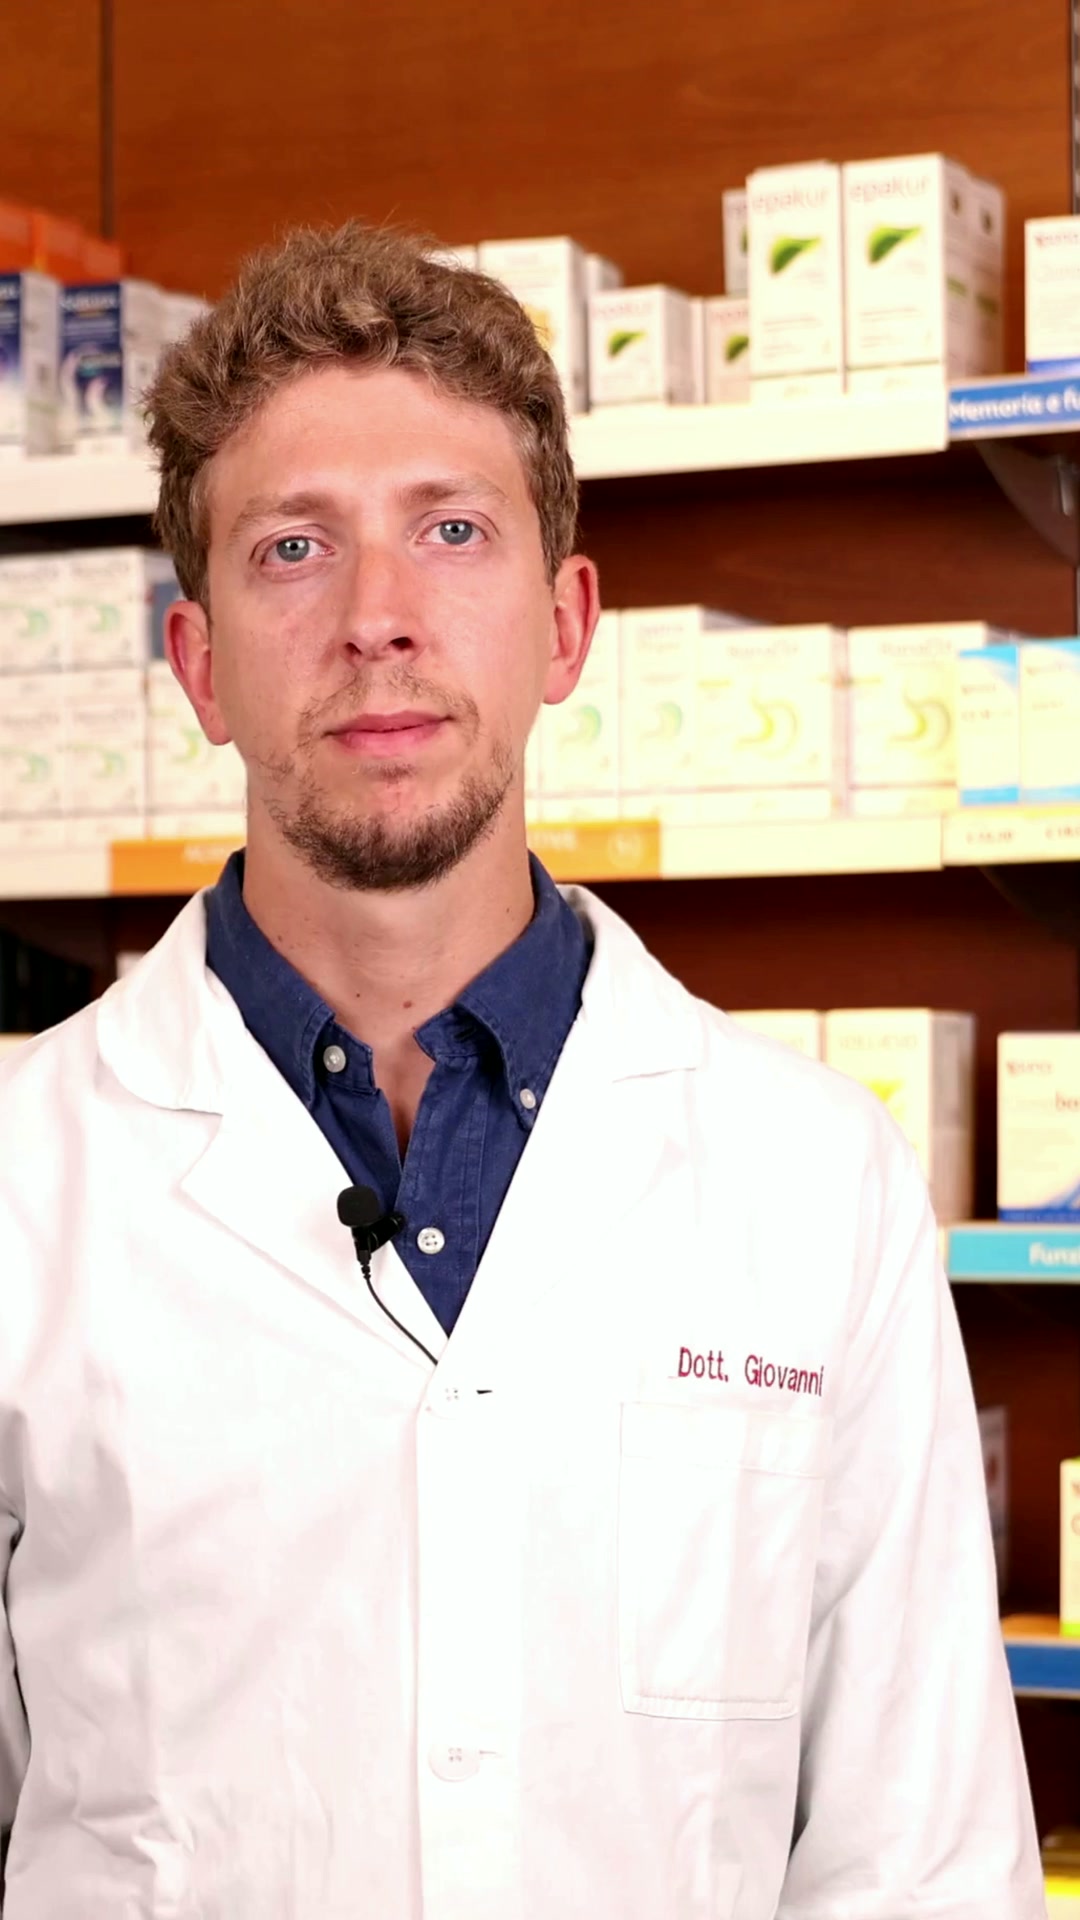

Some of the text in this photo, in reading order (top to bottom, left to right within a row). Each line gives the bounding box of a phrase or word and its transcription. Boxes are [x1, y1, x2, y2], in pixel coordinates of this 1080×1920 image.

[948, 392, 1044, 424] Memoria
[1045, 393, 1061, 414] e
[1029, 1241, 1080, 1267] Funz
[678, 1347, 824, 1396] Dott. Giovanni
